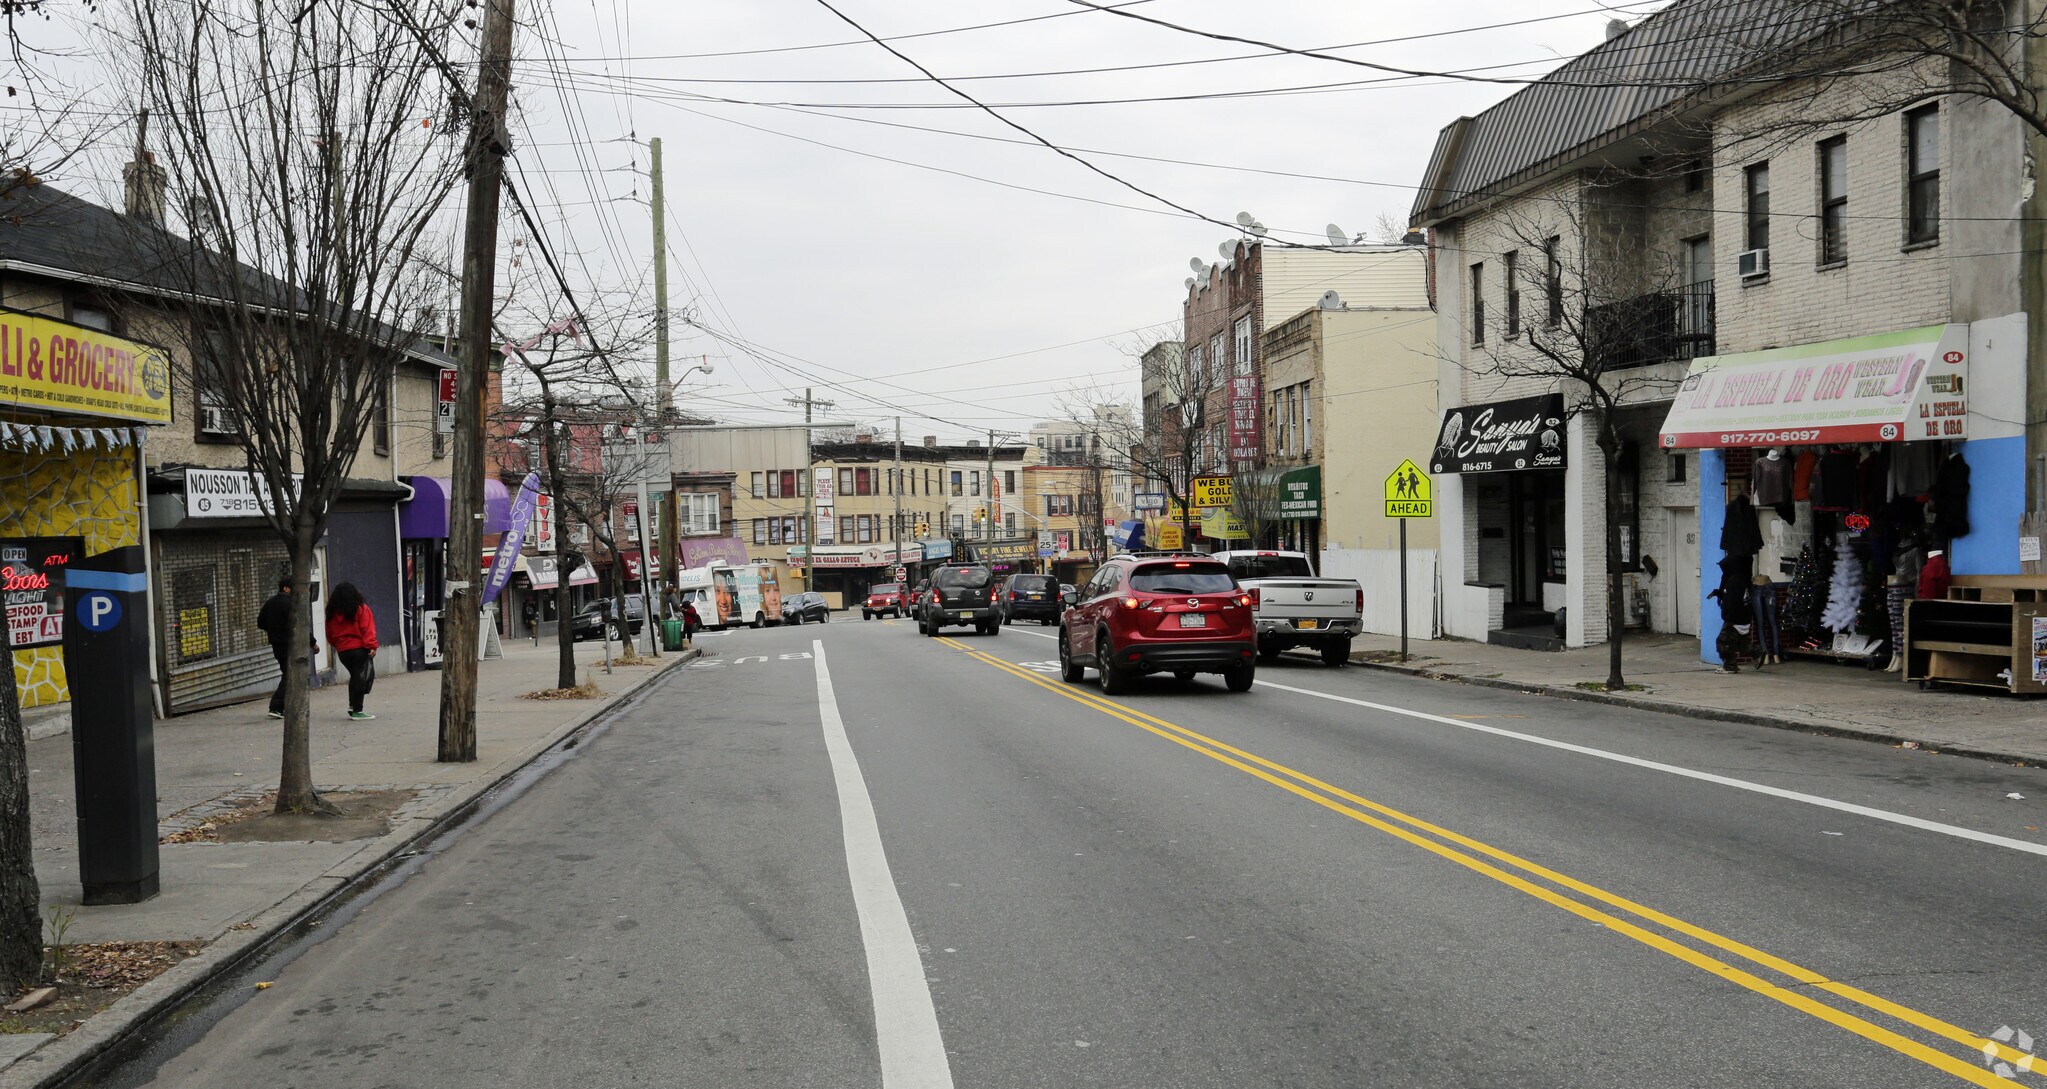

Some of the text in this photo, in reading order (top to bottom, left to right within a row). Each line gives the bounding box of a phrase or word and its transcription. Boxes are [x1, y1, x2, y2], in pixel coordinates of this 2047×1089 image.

[0, 324, 23, 377] LI
[27, 337, 44, 381] &
[50, 334, 137, 395] GROCERY
[1947, 353, 1960, 362] 84
[1853, 354, 1905, 379] WESTERN
[1690, 360, 1855, 409] LA ESPUELA DE ORO
[1853, 376, 1887, 399] WEAR
[441, 403, 448, 415] 2
[1919, 401, 1966, 418] LA ESPUELA
[1882, 426, 1895, 437] 84
[1926, 419, 1963, 437] DE ORO
[1666, 436, 1675, 446] 84
[1720, 429, 1821, 444] 917-770-6097
[1475, 439, 1529, 454] BEAUTY SALON
[1462, 461, 1493, 471] 816-6715
[189, 473, 242, 495] NOUSSON
[1197, 478, 1232, 487] WE BU
[1198, 497, 1206, 505] &
[1209, 496, 1232, 505] SILV
[1390, 503, 1427, 514] AHEAD
[1845, 515, 1870, 528] OPEN
[1040, 541, 1052, 549] 25
[3, 549, 27, 560] OPEN
[43, 554, 70, 567] ATM
[1, 565, 51, 591] Coors
[17, 604, 44, 618] FOOD
[91, 596, 113, 627] P
[7, 616, 38, 630] STAMP
[43, 615, 63, 635] AT
[15, 630, 34, 645] EBT
